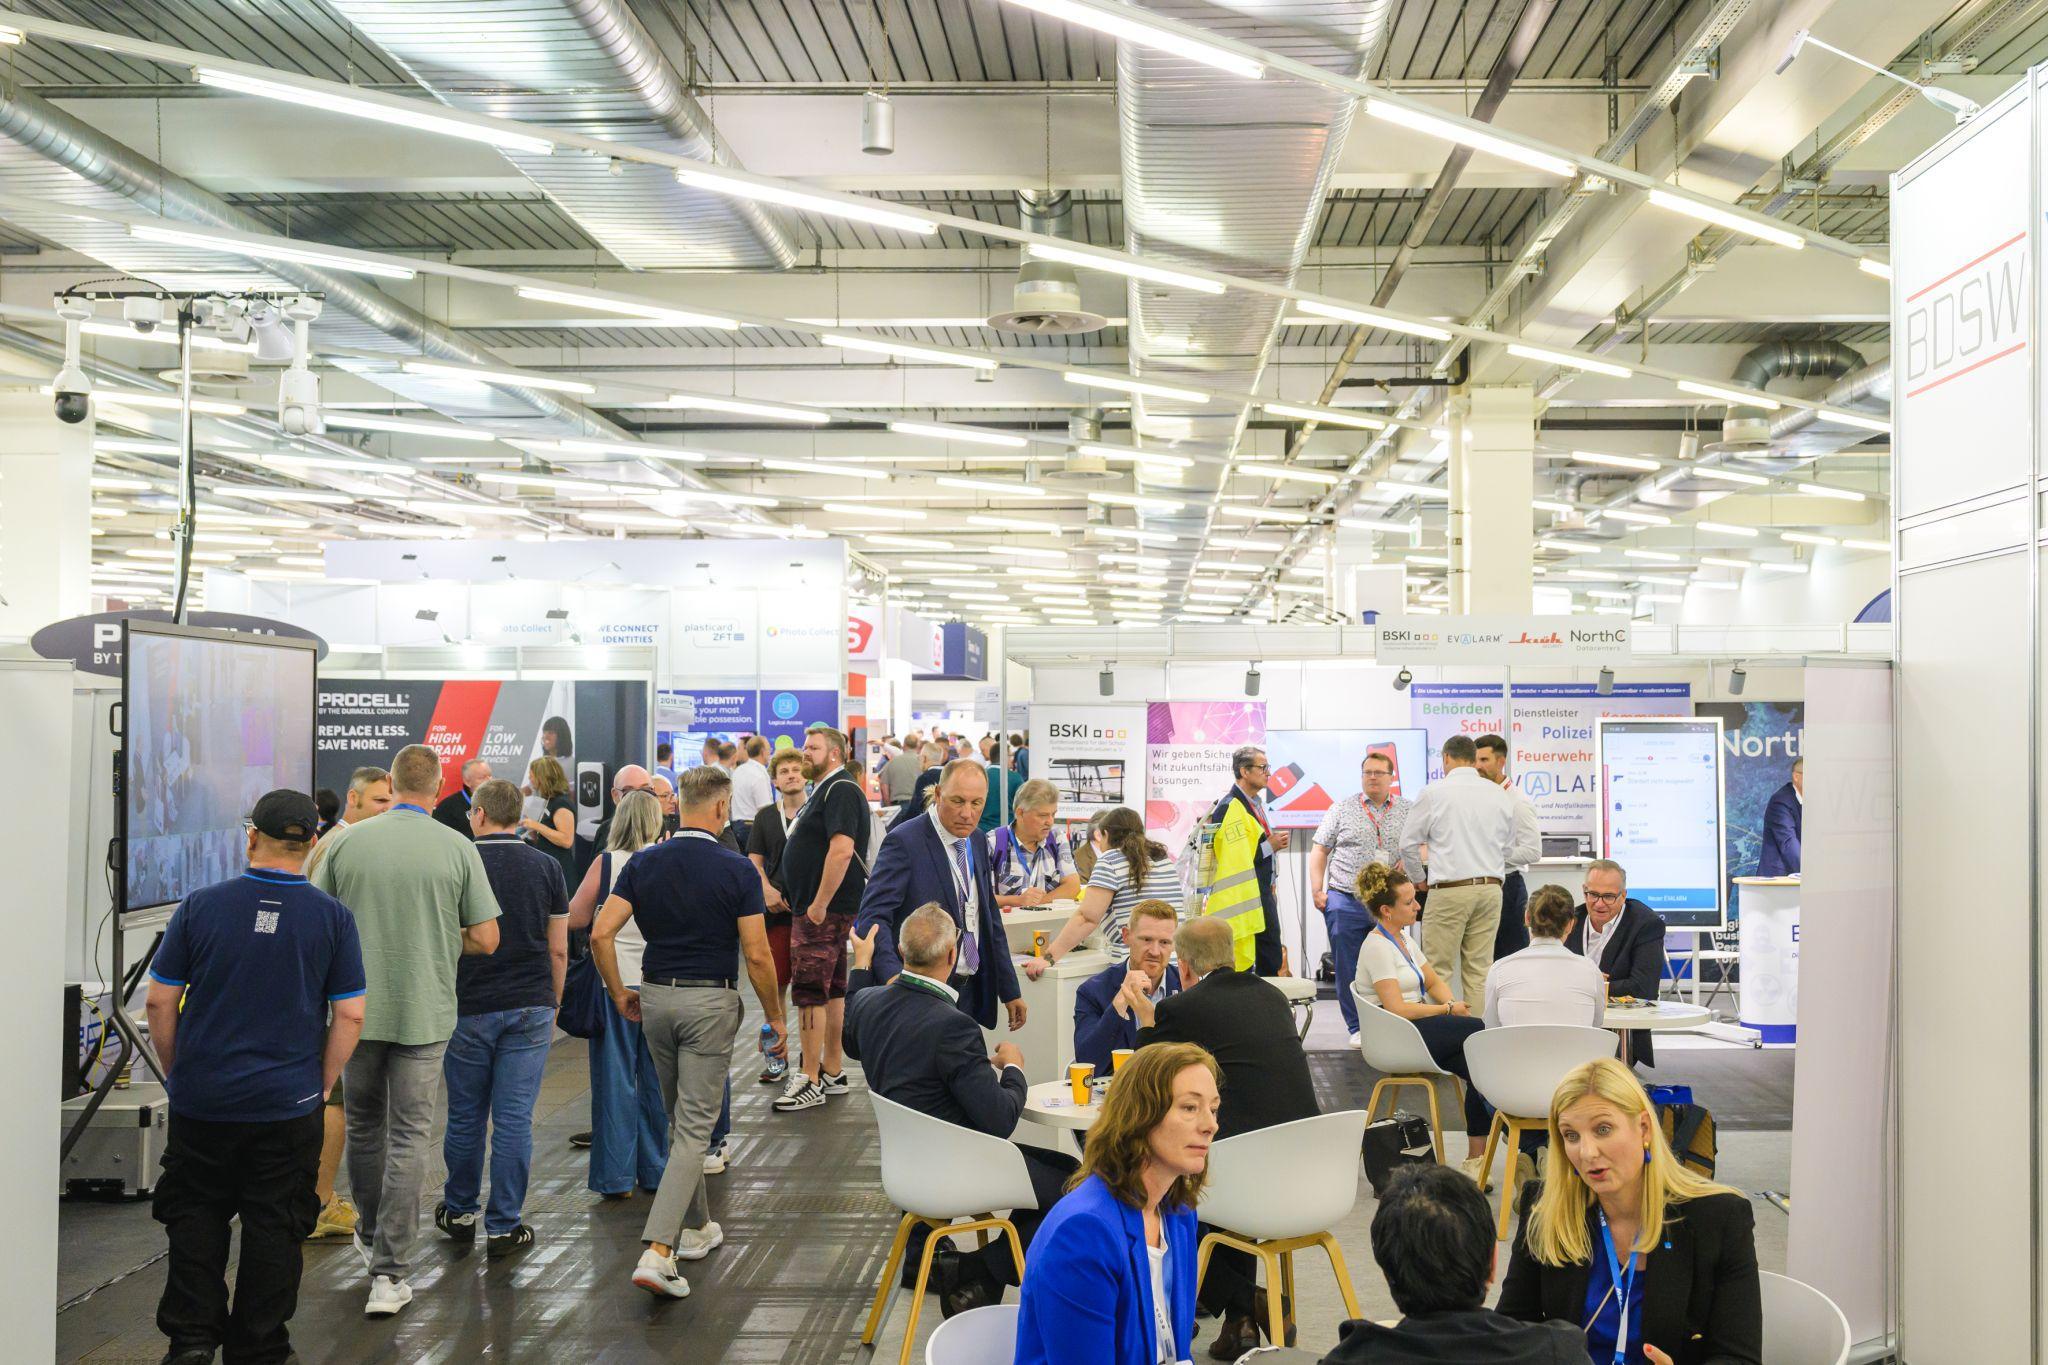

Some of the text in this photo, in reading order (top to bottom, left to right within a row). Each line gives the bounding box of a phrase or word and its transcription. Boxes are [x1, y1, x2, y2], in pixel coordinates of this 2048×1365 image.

[1907, 252, 2025, 381] BDSW
[613, 624, 659, 633] CONNECT
[684, 623, 733, 633] plasticard
[713, 633, 732, 641] ZFT
[1383, 631, 1410, 641] BSKI
[1447, 632, 1500, 645] EVALARM
[1570, 629, 1626, 642] NorthC
[704, 697, 745, 705] IDENTITY
[700, 708, 717, 716] your
[1423, 703, 1492, 715] Behörden
[1513, 708, 1579, 718] Dienstleister
[709, 716, 754, 724] possession.
[1461, 718, 1522, 733] Schuln
[318, 725, 410, 736] REPLACE LESS.
[1050, 724, 1087, 738] BSKI
[1542, 726, 1592, 740] Polizei
[428, 733, 462, 743] HIGH
[486, 733, 516, 744] LOW
[1723, 729, 1803, 757] Nort
[318, 739, 389, 750] SAVE MORE.
[482, 745, 523, 756] DRAIN
[1152, 750, 1169, 758] Wir
[1172, 750, 1201, 759] geben
[1517, 751, 1593, 762] Feuerwehr
[1152, 776, 1202, 785] Lösungen.
